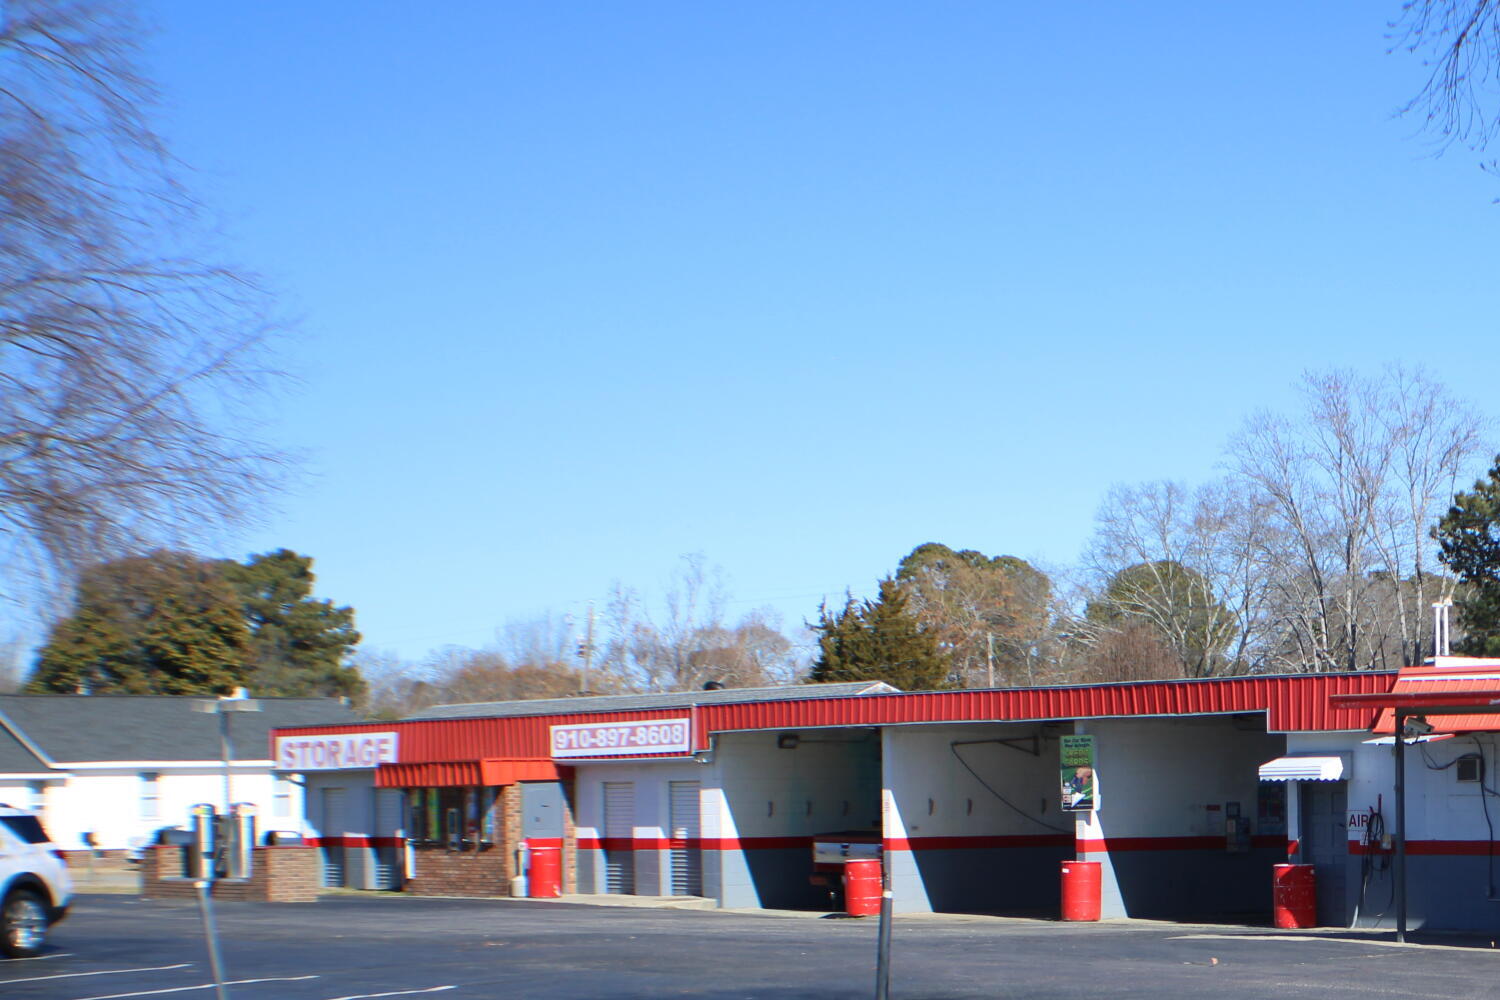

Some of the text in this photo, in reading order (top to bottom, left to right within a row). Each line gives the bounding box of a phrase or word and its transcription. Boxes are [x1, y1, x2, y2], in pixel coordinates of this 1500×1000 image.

[555, 724, 684, 749] 910-897-8608
[284, 738, 391, 768] STORAGE
[1348, 814, 1370, 827] AIR
